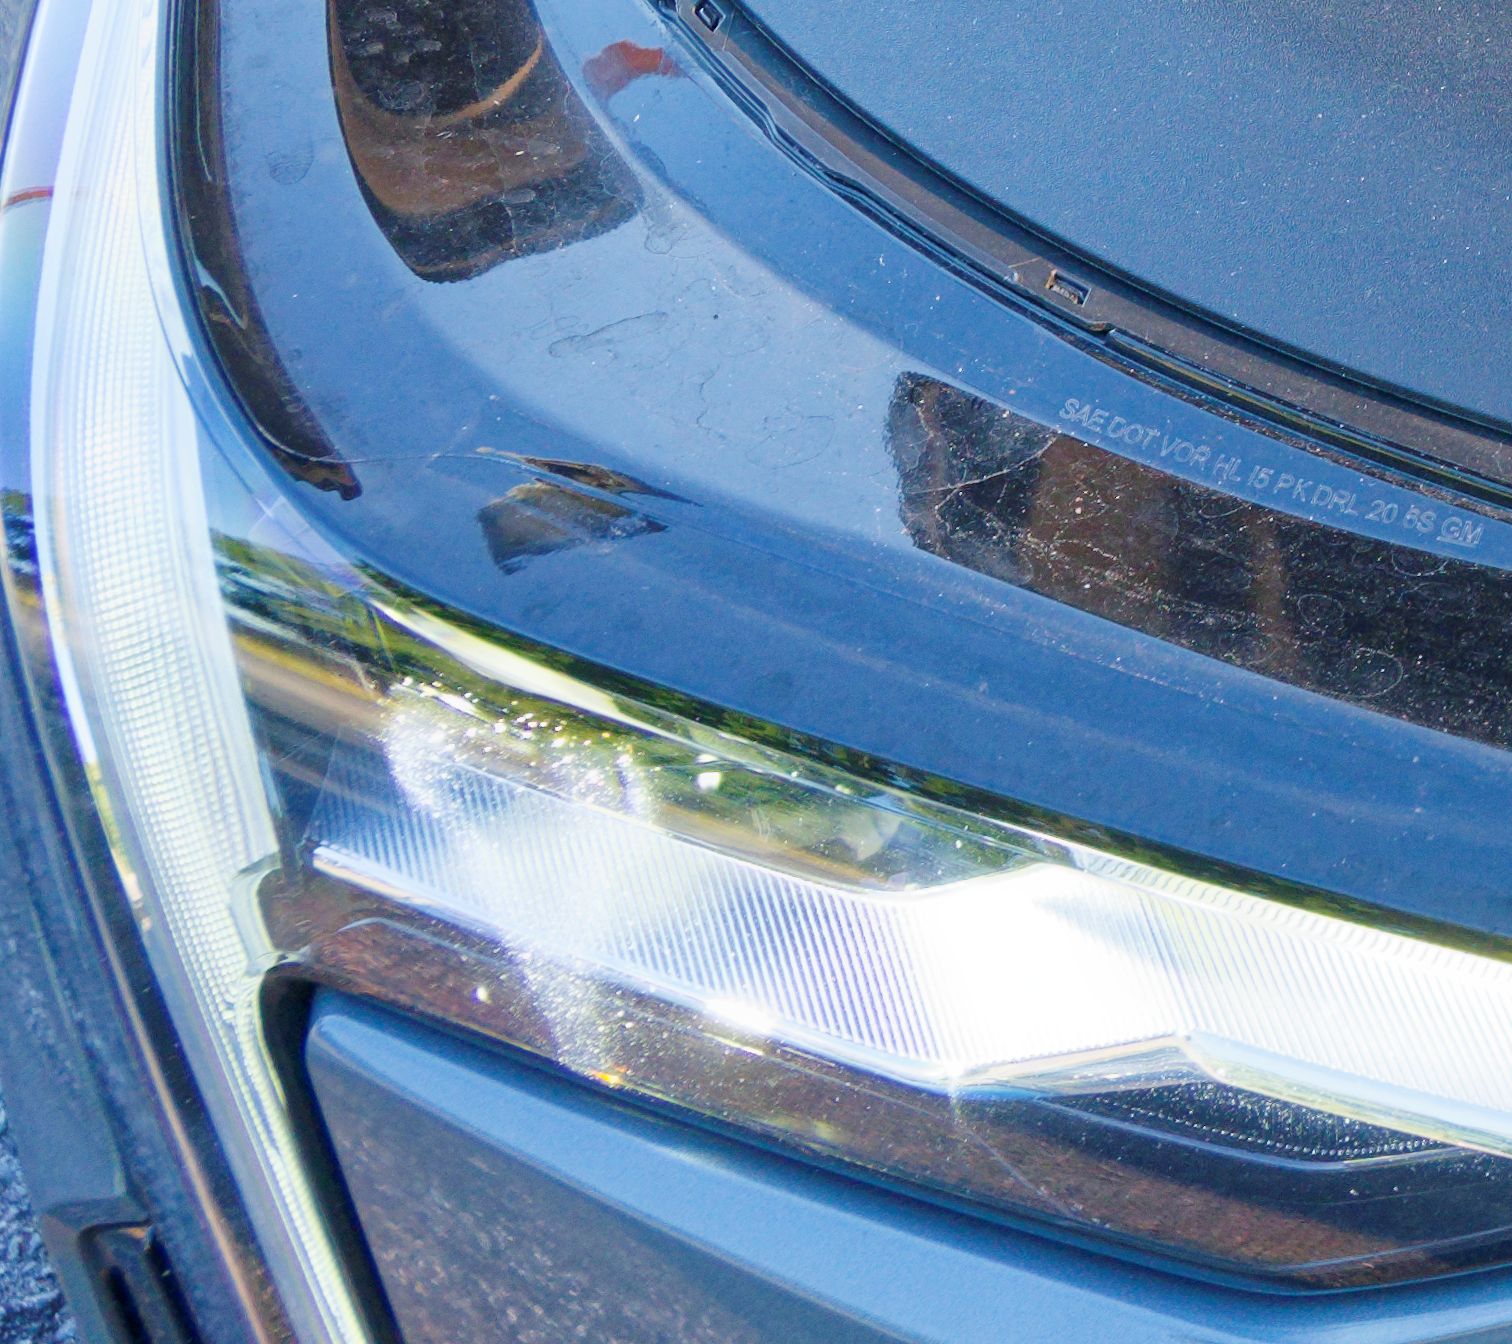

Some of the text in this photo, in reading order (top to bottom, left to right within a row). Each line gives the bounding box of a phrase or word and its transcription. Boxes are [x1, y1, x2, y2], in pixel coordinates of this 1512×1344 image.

[1059, 398, 1109, 433] SAE
[1107, 416, 1161, 449] DOT
[1159, 435, 1212, 471] VOR
[1212, 454, 1242, 483] HL
[1365, 499, 1399, 524] 20
[1438, 516, 1484, 546] GM
